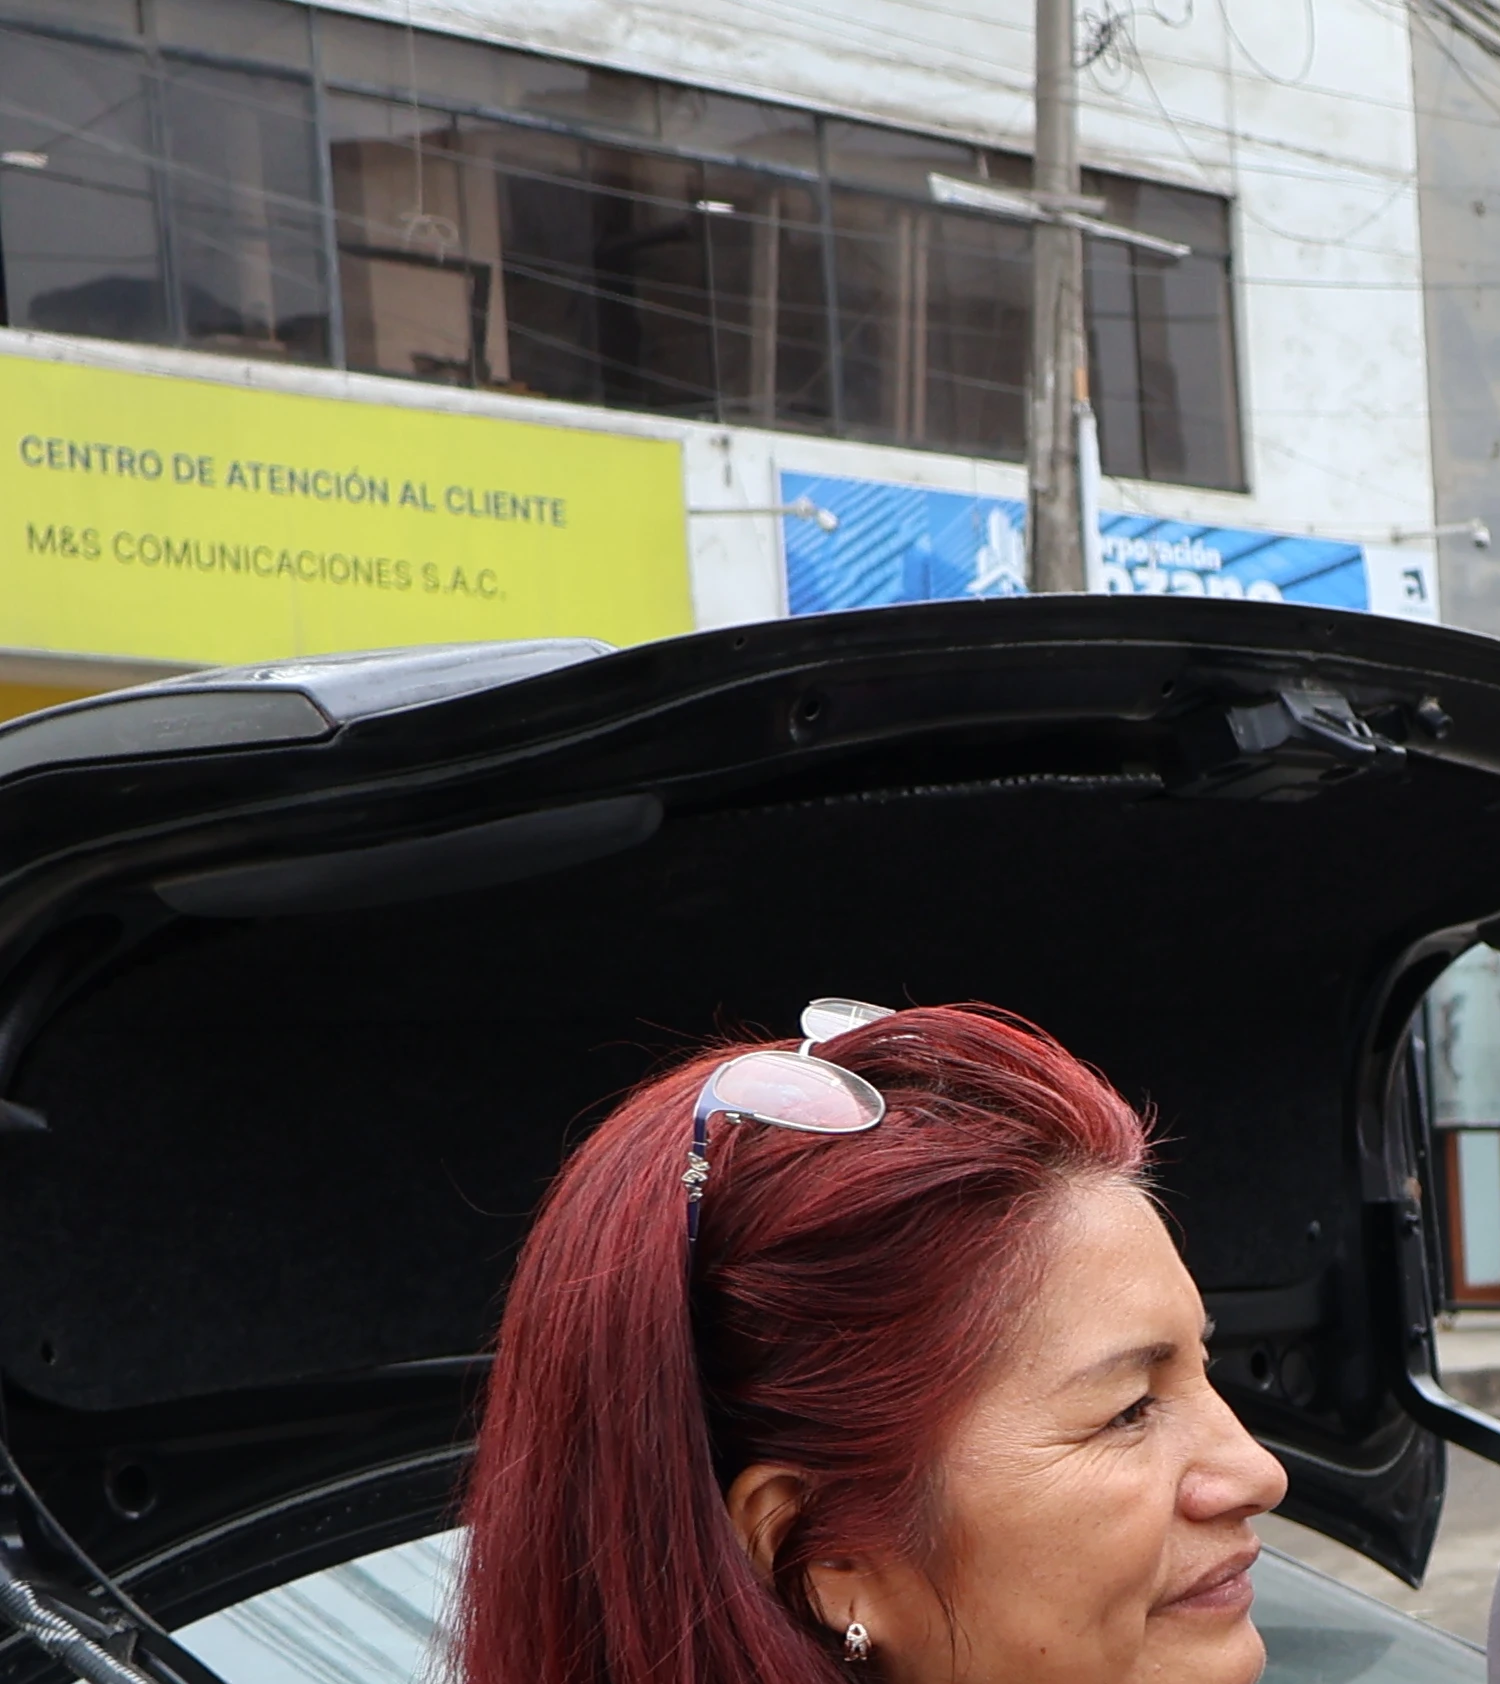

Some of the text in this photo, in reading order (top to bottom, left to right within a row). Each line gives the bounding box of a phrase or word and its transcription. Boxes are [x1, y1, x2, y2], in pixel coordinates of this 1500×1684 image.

[20, 435, 568, 528] CENTRO DE ATENCIÓN AL CLIENTE
[26, 522, 508, 600] M&S COMUNICACIONES S.A.C.
